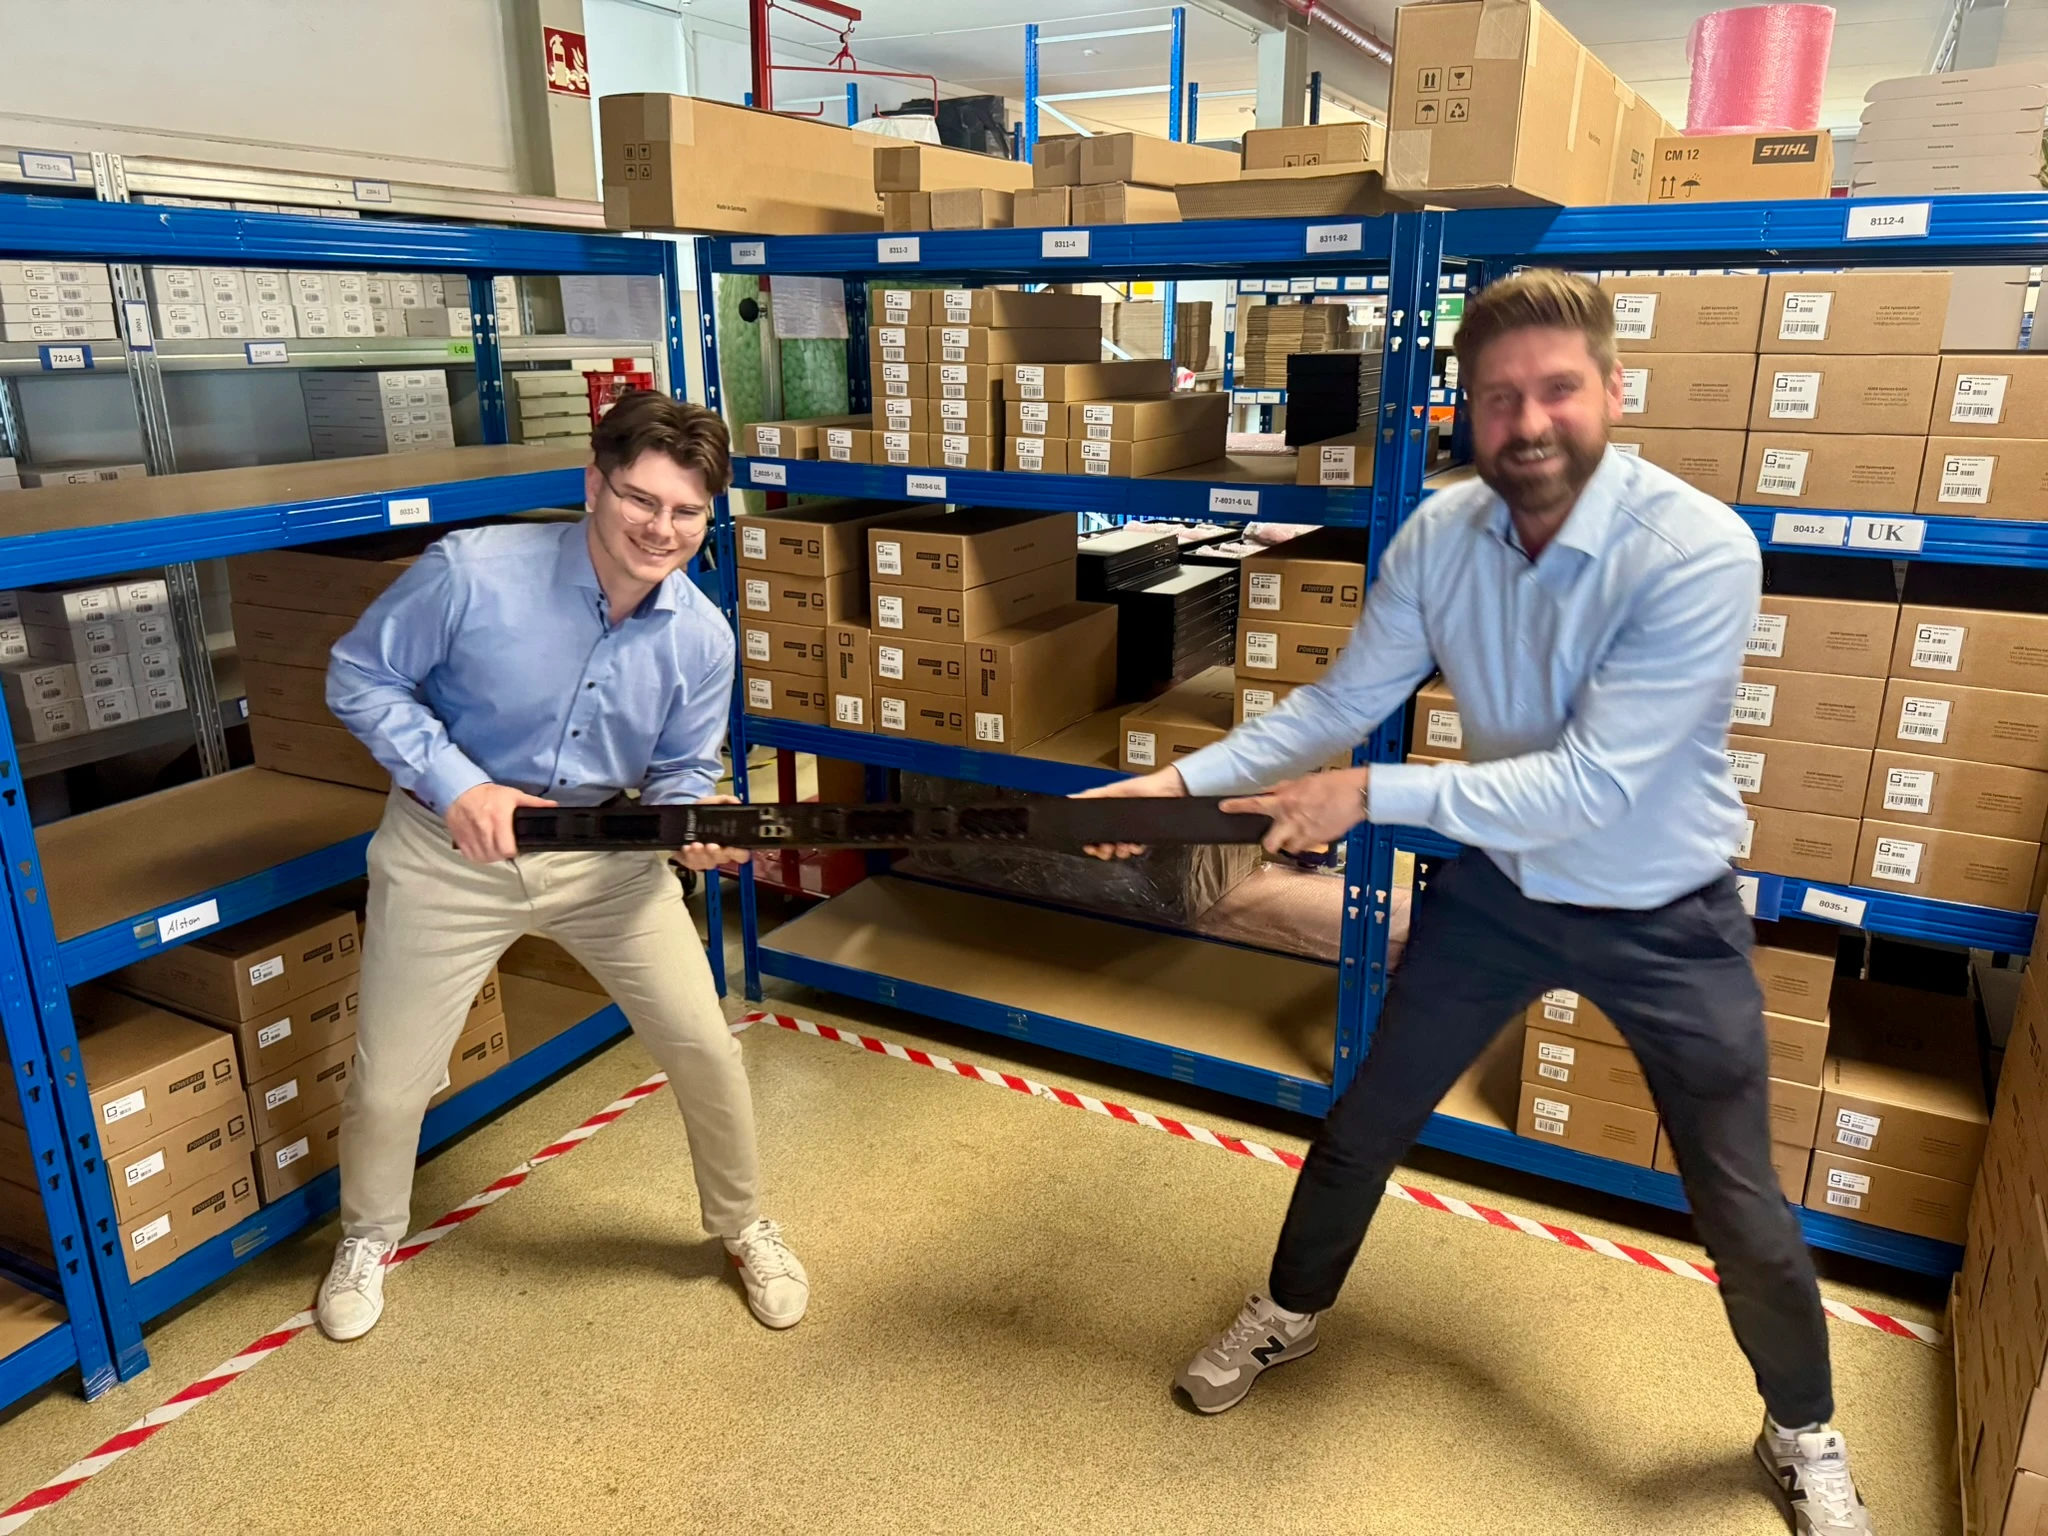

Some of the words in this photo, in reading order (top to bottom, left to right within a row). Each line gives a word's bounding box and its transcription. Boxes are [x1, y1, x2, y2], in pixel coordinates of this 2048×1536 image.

[1665, 150, 1683, 161] CM
[1687, 149, 1699, 160] 12
[1760, 144, 1810, 157] STIHL
[1870, 216, 1905, 226] 8112-4
[1065, 240, 1085, 248] 8311-4
[1319, 234, 1348, 243] 8311-92
[53, 354, 82, 363] 7214-3
[1215, 497, 1242, 505] 7-8031-6
[1793, 525, 1824, 534] 8041-2
[1867, 523, 1905, 542] UK
[1301, 584, 1334, 594] POWERED
[1341, 586, 1357, 602] G
[1297, 645, 1329, 655] POWERED
[1819, 900, 1848, 913] 8035-1
[167, 917, 200, 935] Alstom
[213, 1058, 231, 1079] G
[170, 1070, 204, 1093] POWERED
[228, 1115, 244, 1136] G
[187, 1128, 220, 1152] POWERED
[232, 1177, 248, 1198] G
[192, 1191, 224, 1215] POWERED
